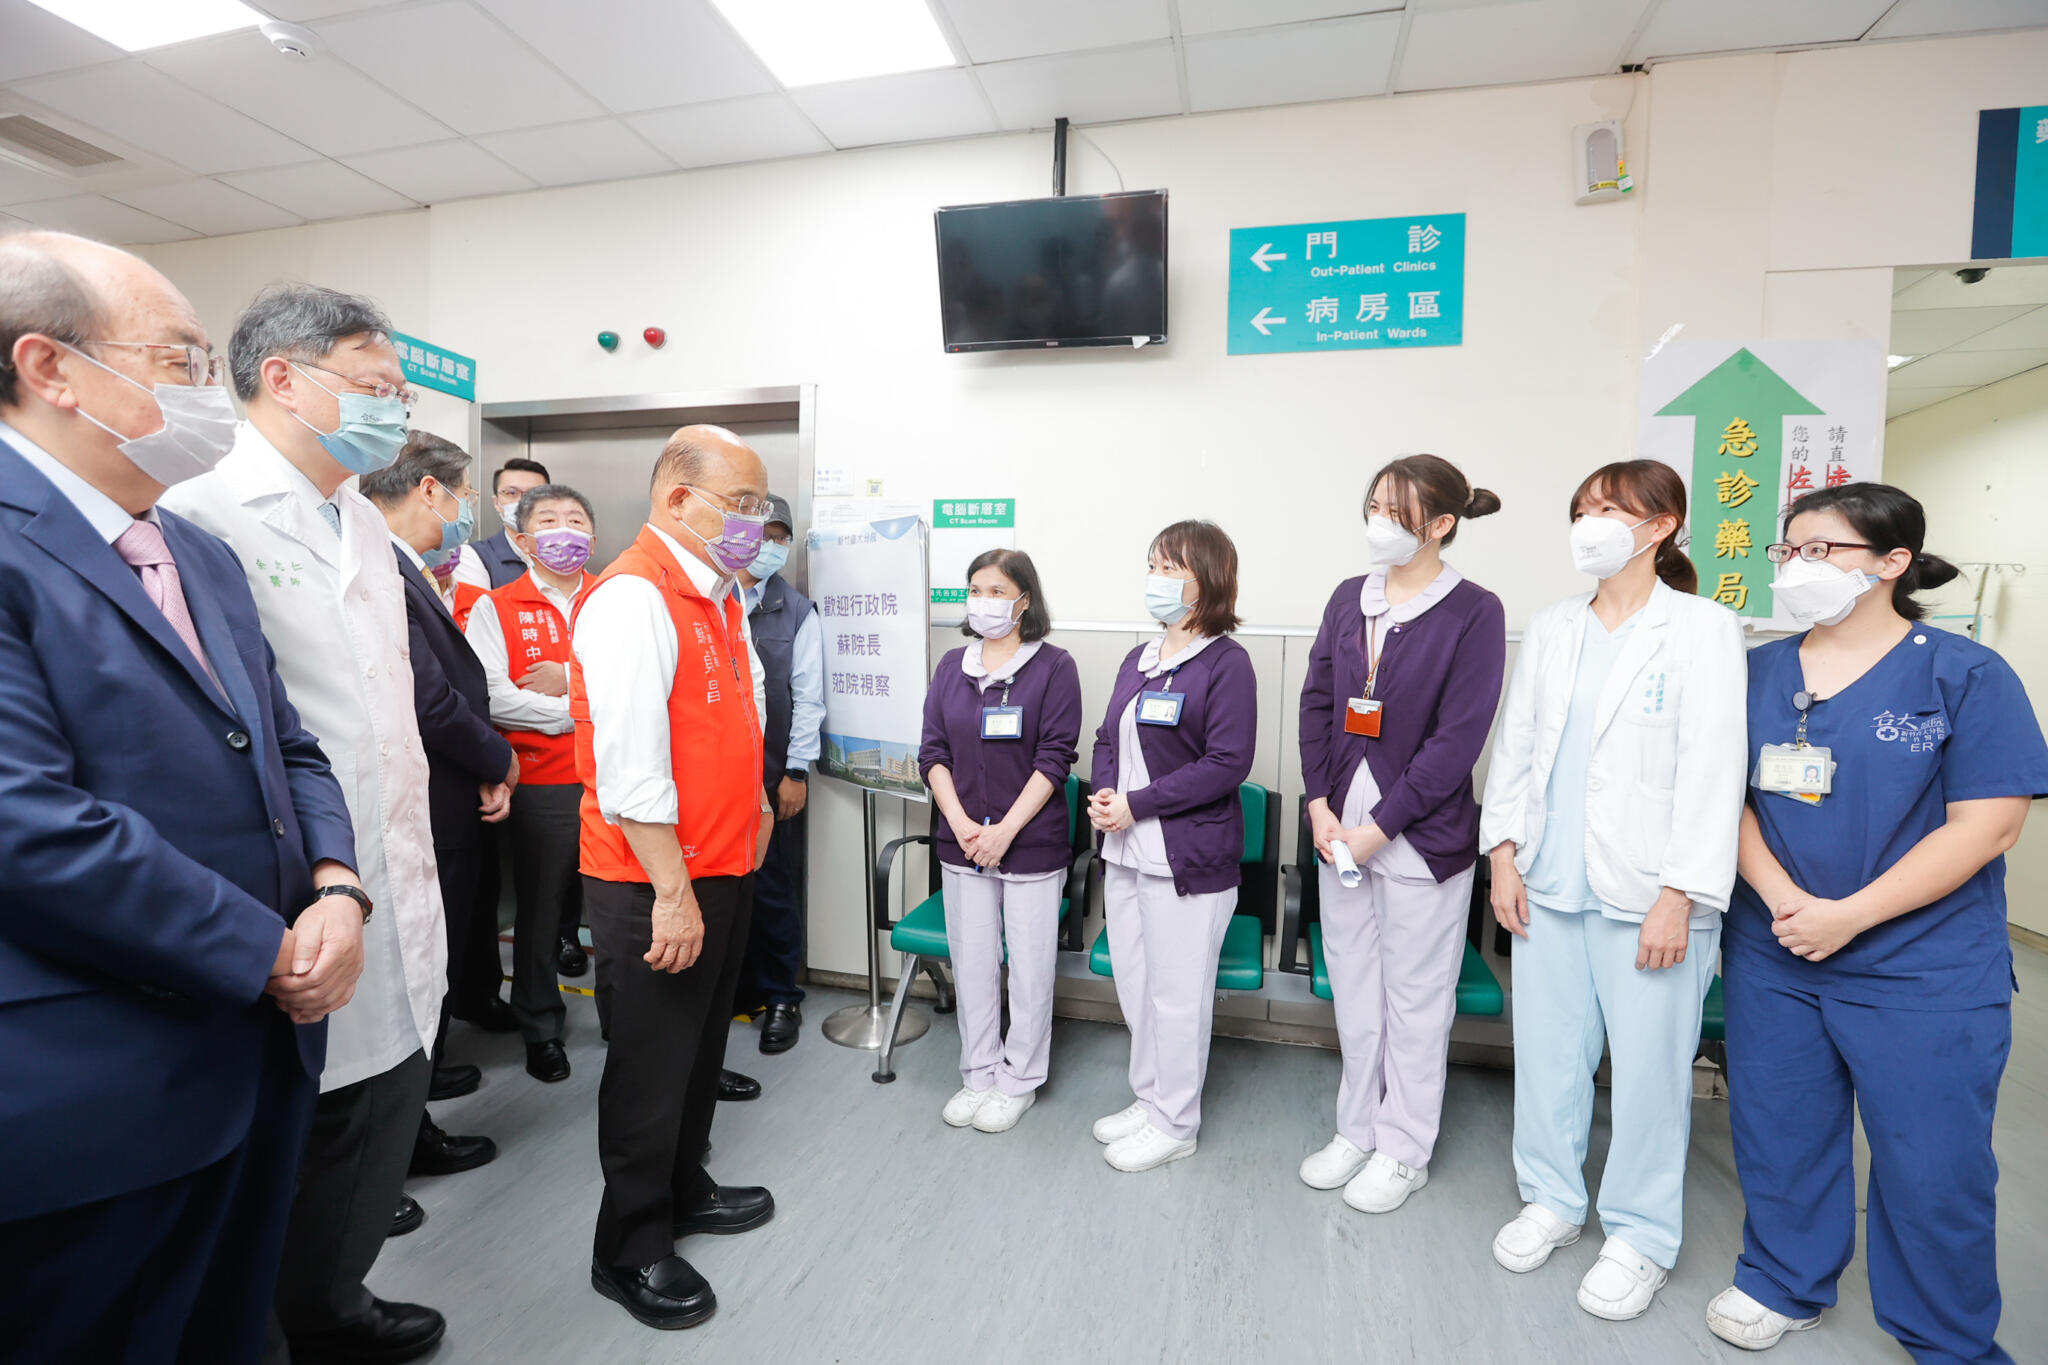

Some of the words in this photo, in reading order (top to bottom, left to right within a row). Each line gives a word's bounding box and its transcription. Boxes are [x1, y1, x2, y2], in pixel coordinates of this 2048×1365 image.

[1305, 224, 1442, 260] 門診
[1311, 263, 1385, 278] Out-Patient
[1393, 261, 1436, 273] Clinics
[1305, 291, 1441, 324] 病房區
[1316, 329, 1378, 342] In-Patient
[1387, 327, 1427, 339] Wards
[408, 363, 418, 372] CT
[1787, 425, 1815, 500] 您的左
[942, 502, 1008, 516] 電腦斷層室
[1711, 417, 1759, 611] 急診藥局
[823, 592, 898, 617] 歡迎行政院
[518, 611, 541, 661] 陳時中
[837, 634, 881, 657] 蘇院長
[831, 672, 890, 697] 蒞院視察
[1911, 742, 1934, 753] ER
